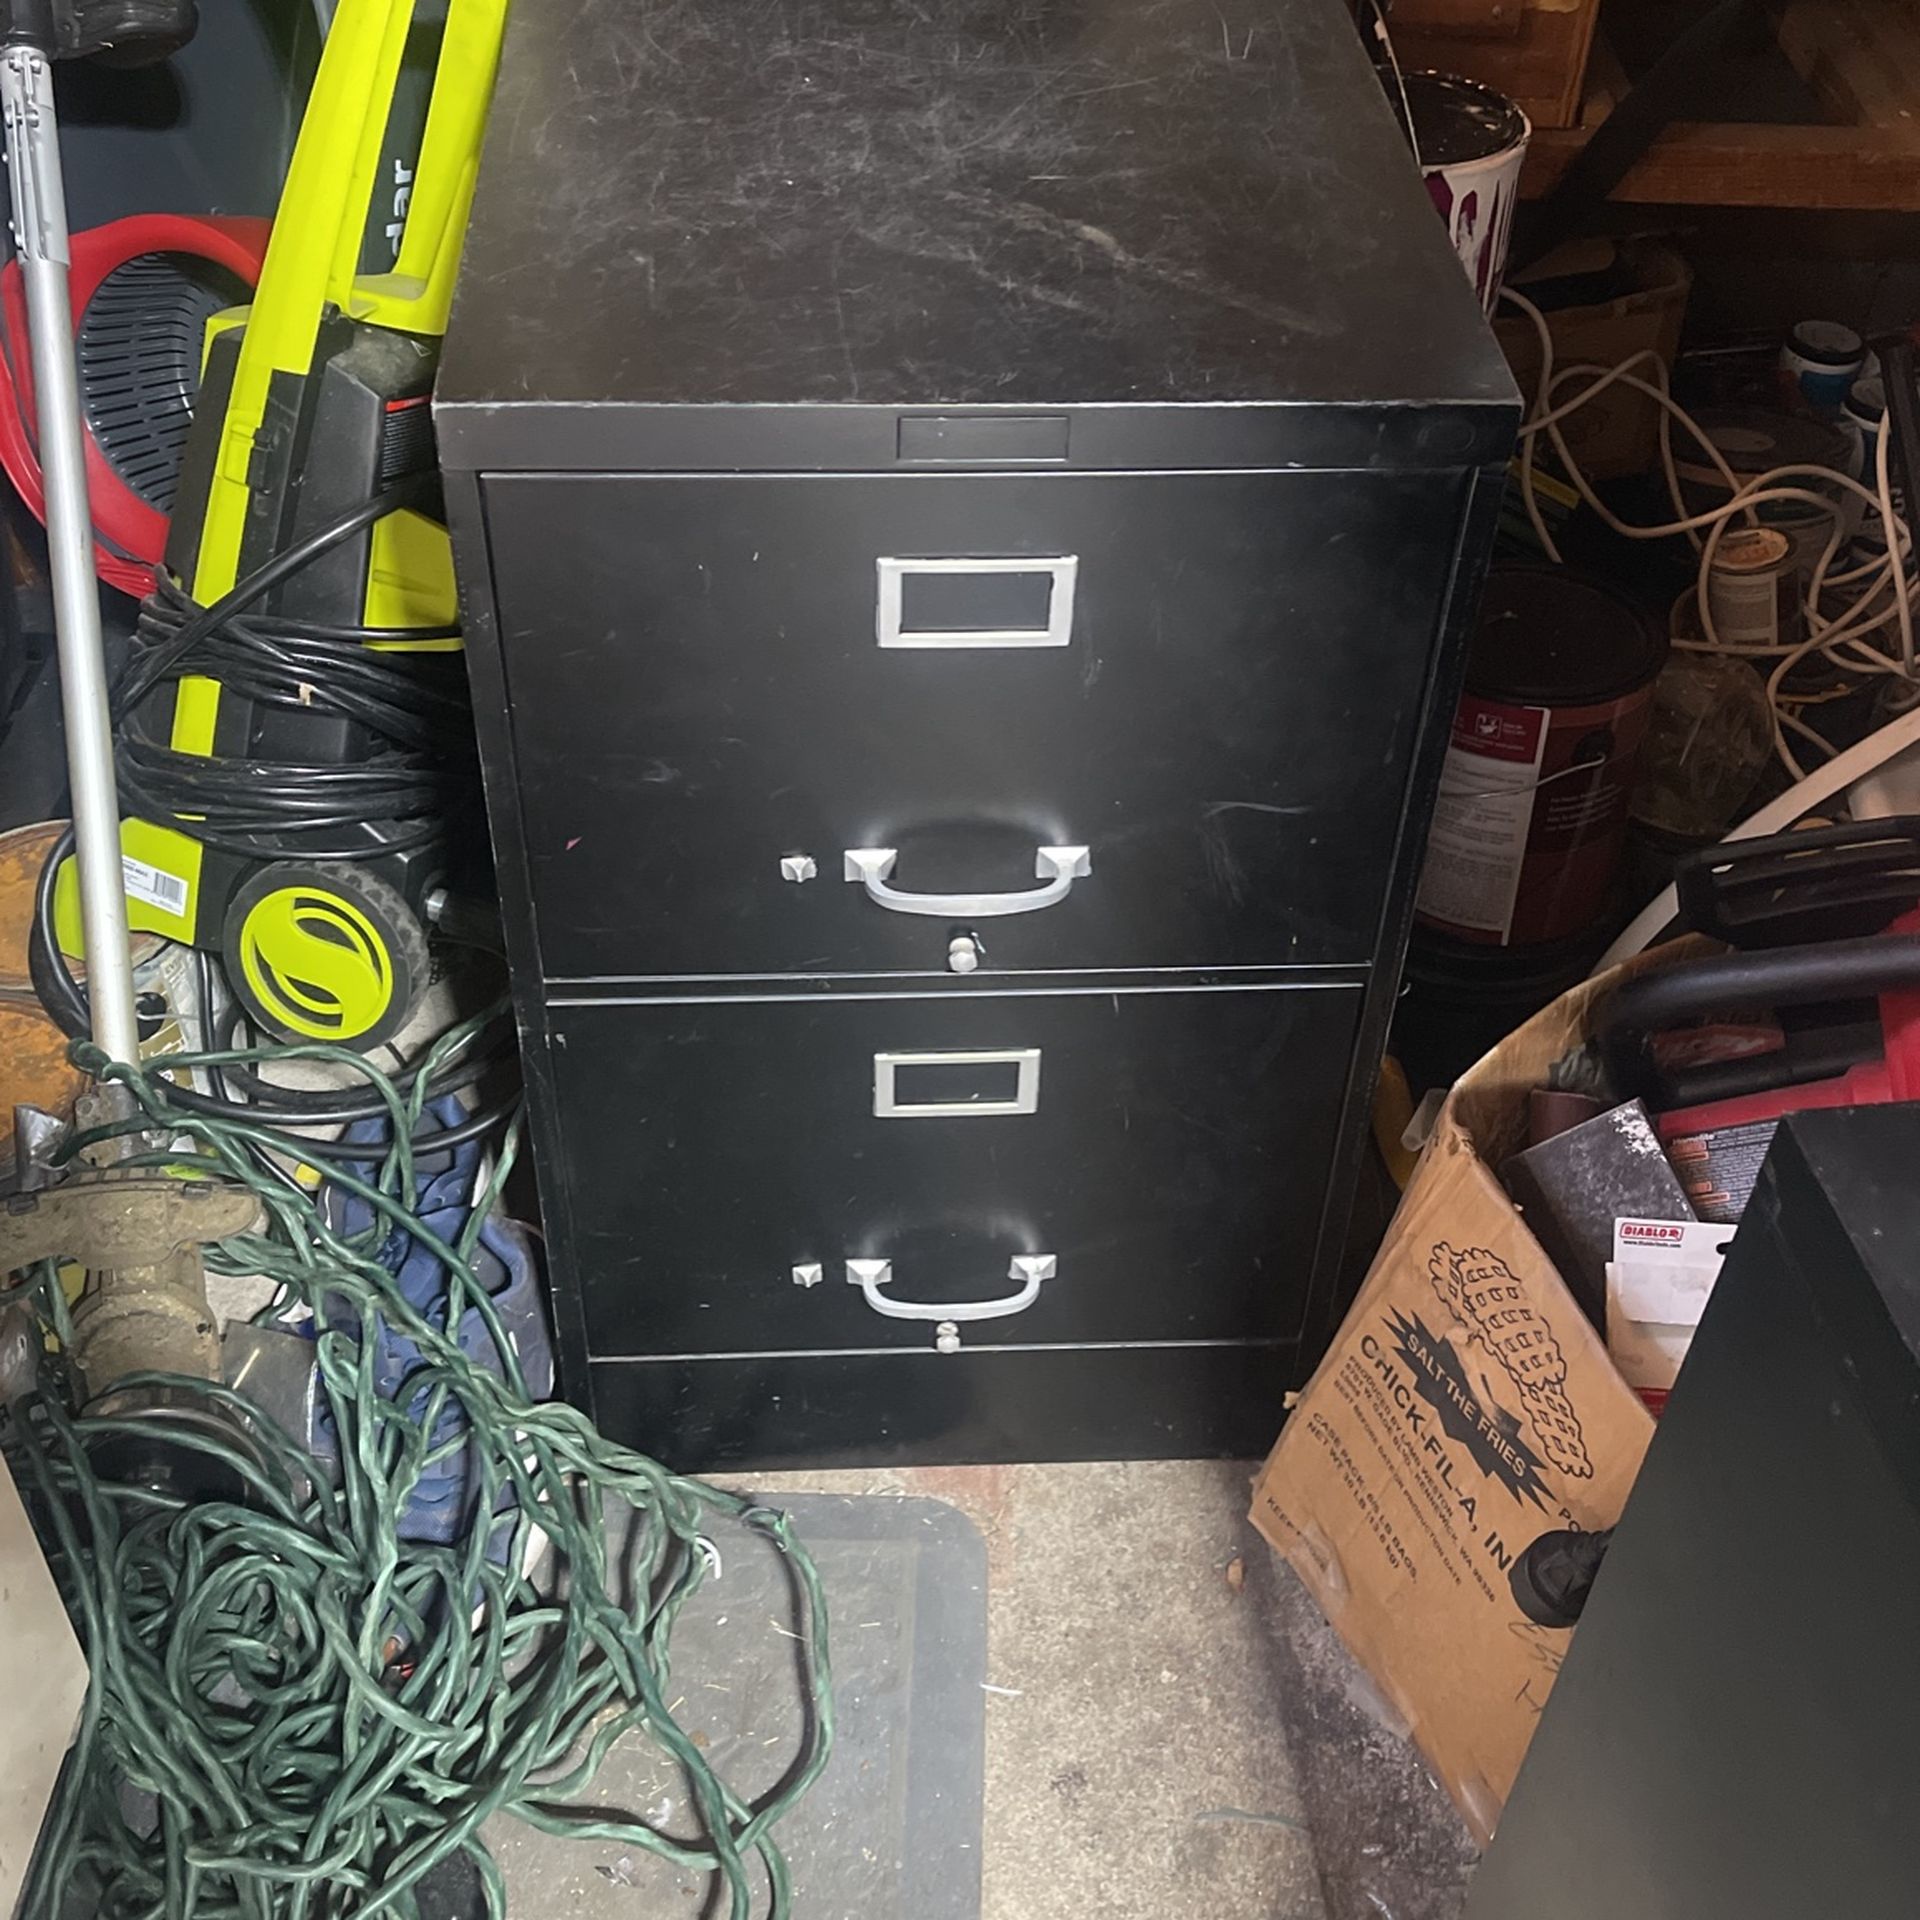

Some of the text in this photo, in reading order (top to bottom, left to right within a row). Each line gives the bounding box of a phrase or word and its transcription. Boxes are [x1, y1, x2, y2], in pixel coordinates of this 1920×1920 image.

[1624, 1226, 1668, 1238] DIABLO
[1306, 1421, 1328, 1446] NET
[1329, 1447, 1344, 1468] WT
[1352, 1489, 1366, 1510] LB
[1348, 1354, 1453, 1518] PRODUCED BY LAMB WESTON
[1360, 1334, 1478, 1533] CHICK-FIL-A,
[1405, 1332, 1527, 1477] SALT THE FRIES
[1312, 1412, 1342, 1448] CASE
[1378, 1514, 1392, 1536] LB
[1377, 1445, 1394, 1472] DATE
[1442, 1556, 1460, 1585] DATE
[1459, 1546, 1472, 1568] WA
